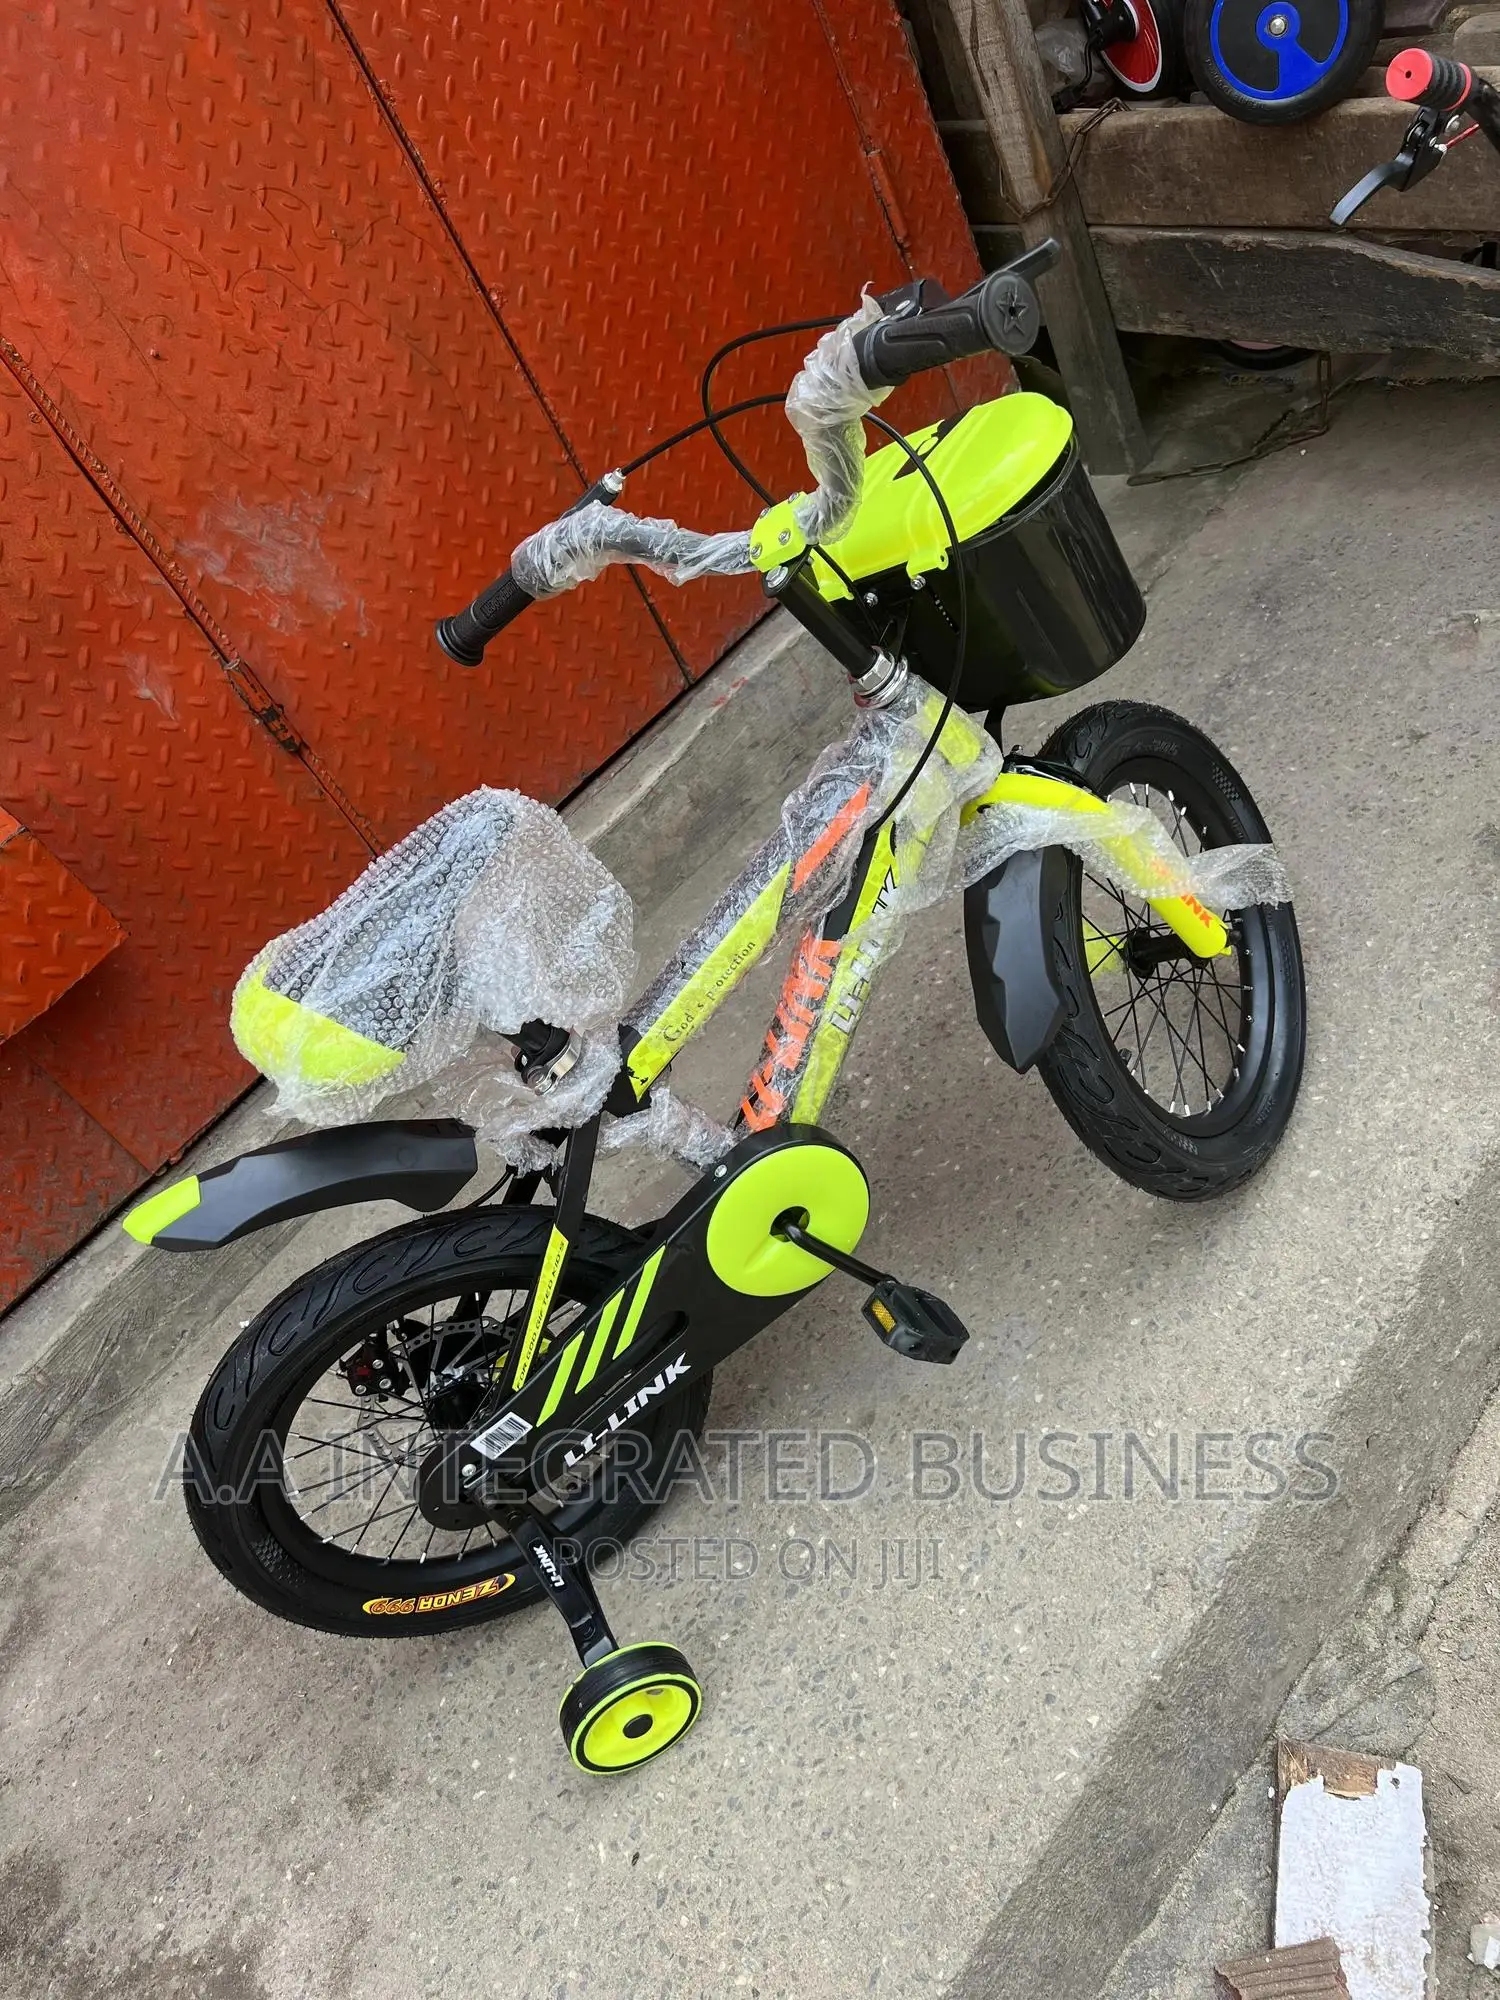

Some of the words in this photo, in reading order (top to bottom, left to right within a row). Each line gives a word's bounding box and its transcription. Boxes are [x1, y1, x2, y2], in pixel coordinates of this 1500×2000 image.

[525, 1332, 537, 1361] GOD
[563, 1351, 692, 1468] LI-LINK
[416, 1575, 501, 1613] ZENDA
